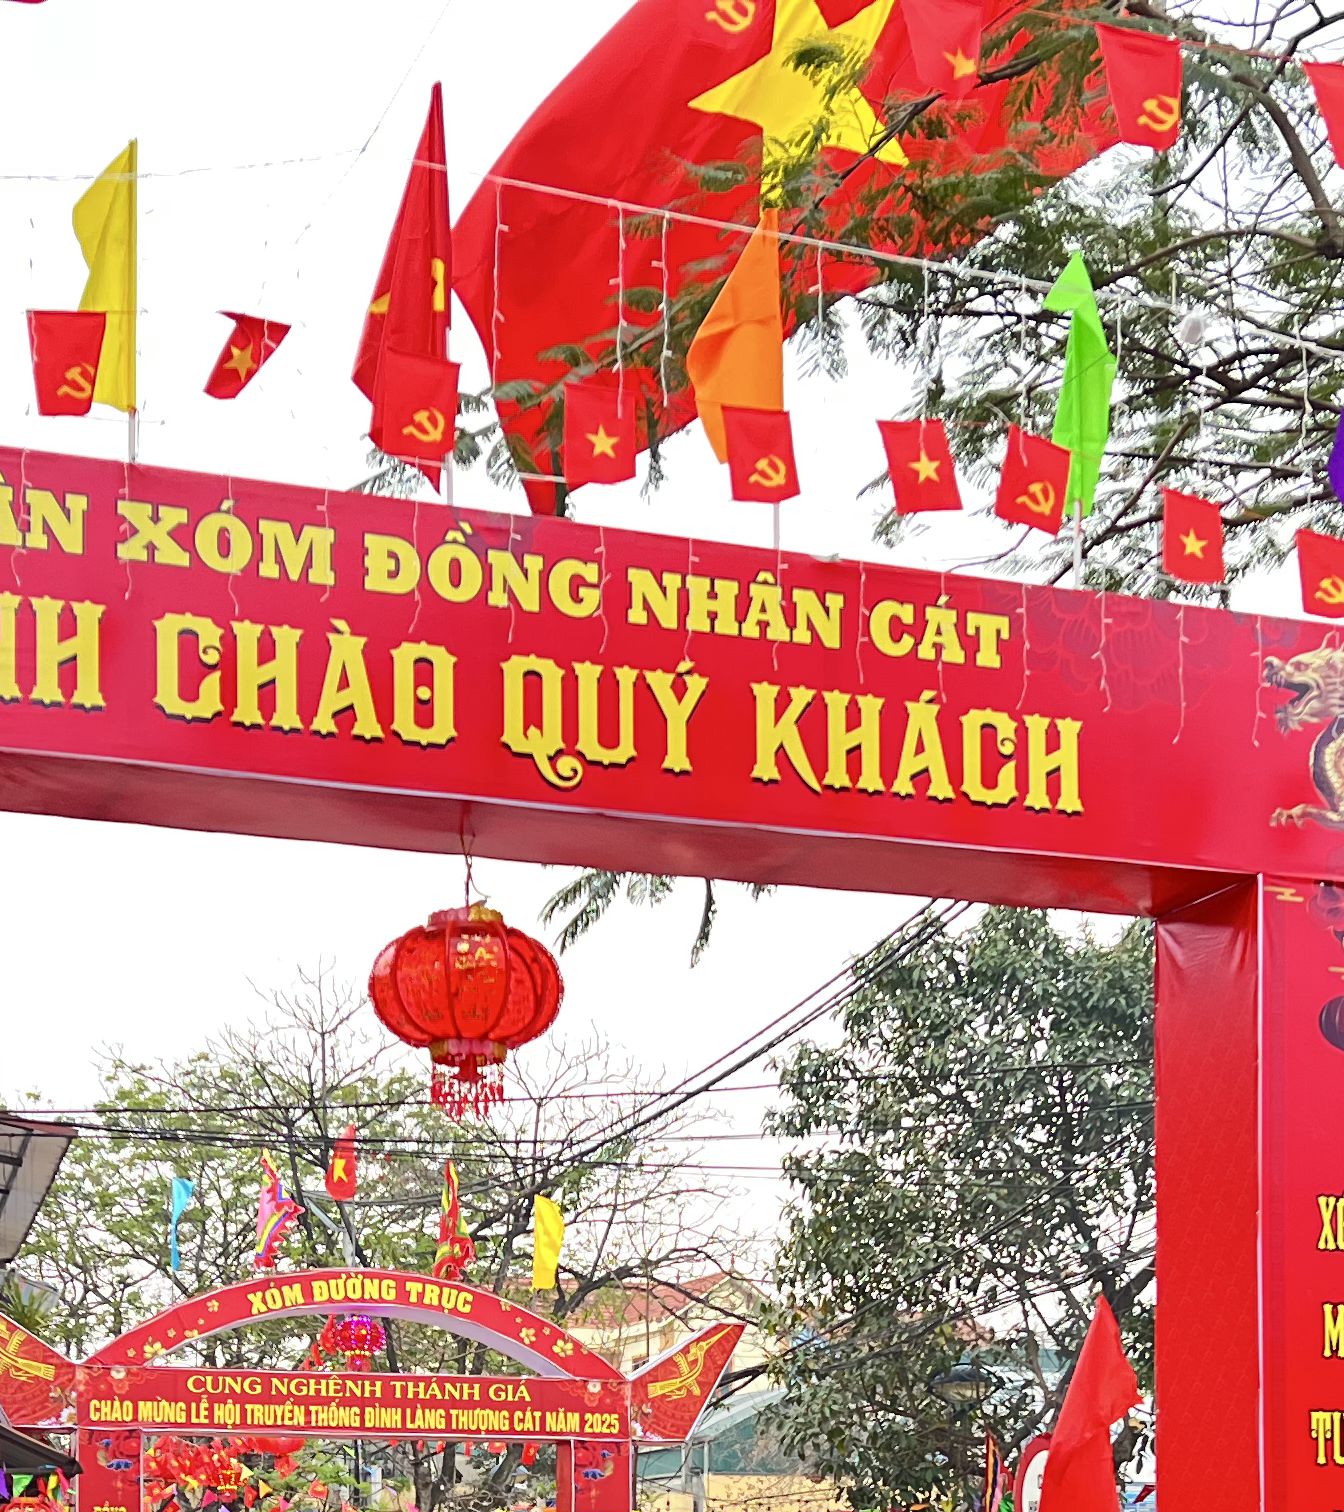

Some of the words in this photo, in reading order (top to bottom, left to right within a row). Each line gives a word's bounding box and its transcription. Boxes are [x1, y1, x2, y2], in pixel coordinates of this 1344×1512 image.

[118, 501, 335, 585] XÓM
[365, 523, 600, 616] ĐỒNG
[629, 569, 843, 648] NHÂN
[871, 596, 1009, 667] CÁT
[156, 615, 456, 745] CHÀO
[503, 656, 707, 785] QUÝ
[752, 683, 1082, 812] KHÁCH
[247, 1281, 304, 1315] XÓM
[312, 1273, 396, 1303] ĐƯỜNG
[406, 1281, 473, 1313] TRỤC
[187, 1375, 262, 1395] CUNG
[271, 1375, 382, 1398] NGHÊNH
[390, 1377, 481, 1400] THÁNH
[489, 1380, 531, 1401] GIÁ
[89, 1395, 133, 1422] CHÀO
[138, 1396, 187, 1424] MỪNG
[191, 1394, 209, 1424] LỄ
[213, 1399, 241, 1429] HỘI
[246, 1397, 305, 1426] TRUYỀN
[310, 1399, 360, 1427] THỐNG
[364, 1403, 402, 1429] ĐÌNH
[406, 1403, 446, 1430] LÀNG
[449, 1407, 510, 1435] THƯỢNG
[513, 1406, 542, 1432] CÁT
[545, 1408, 580, 1433] NĂM
[584, 1413, 620, 1434] 2025
